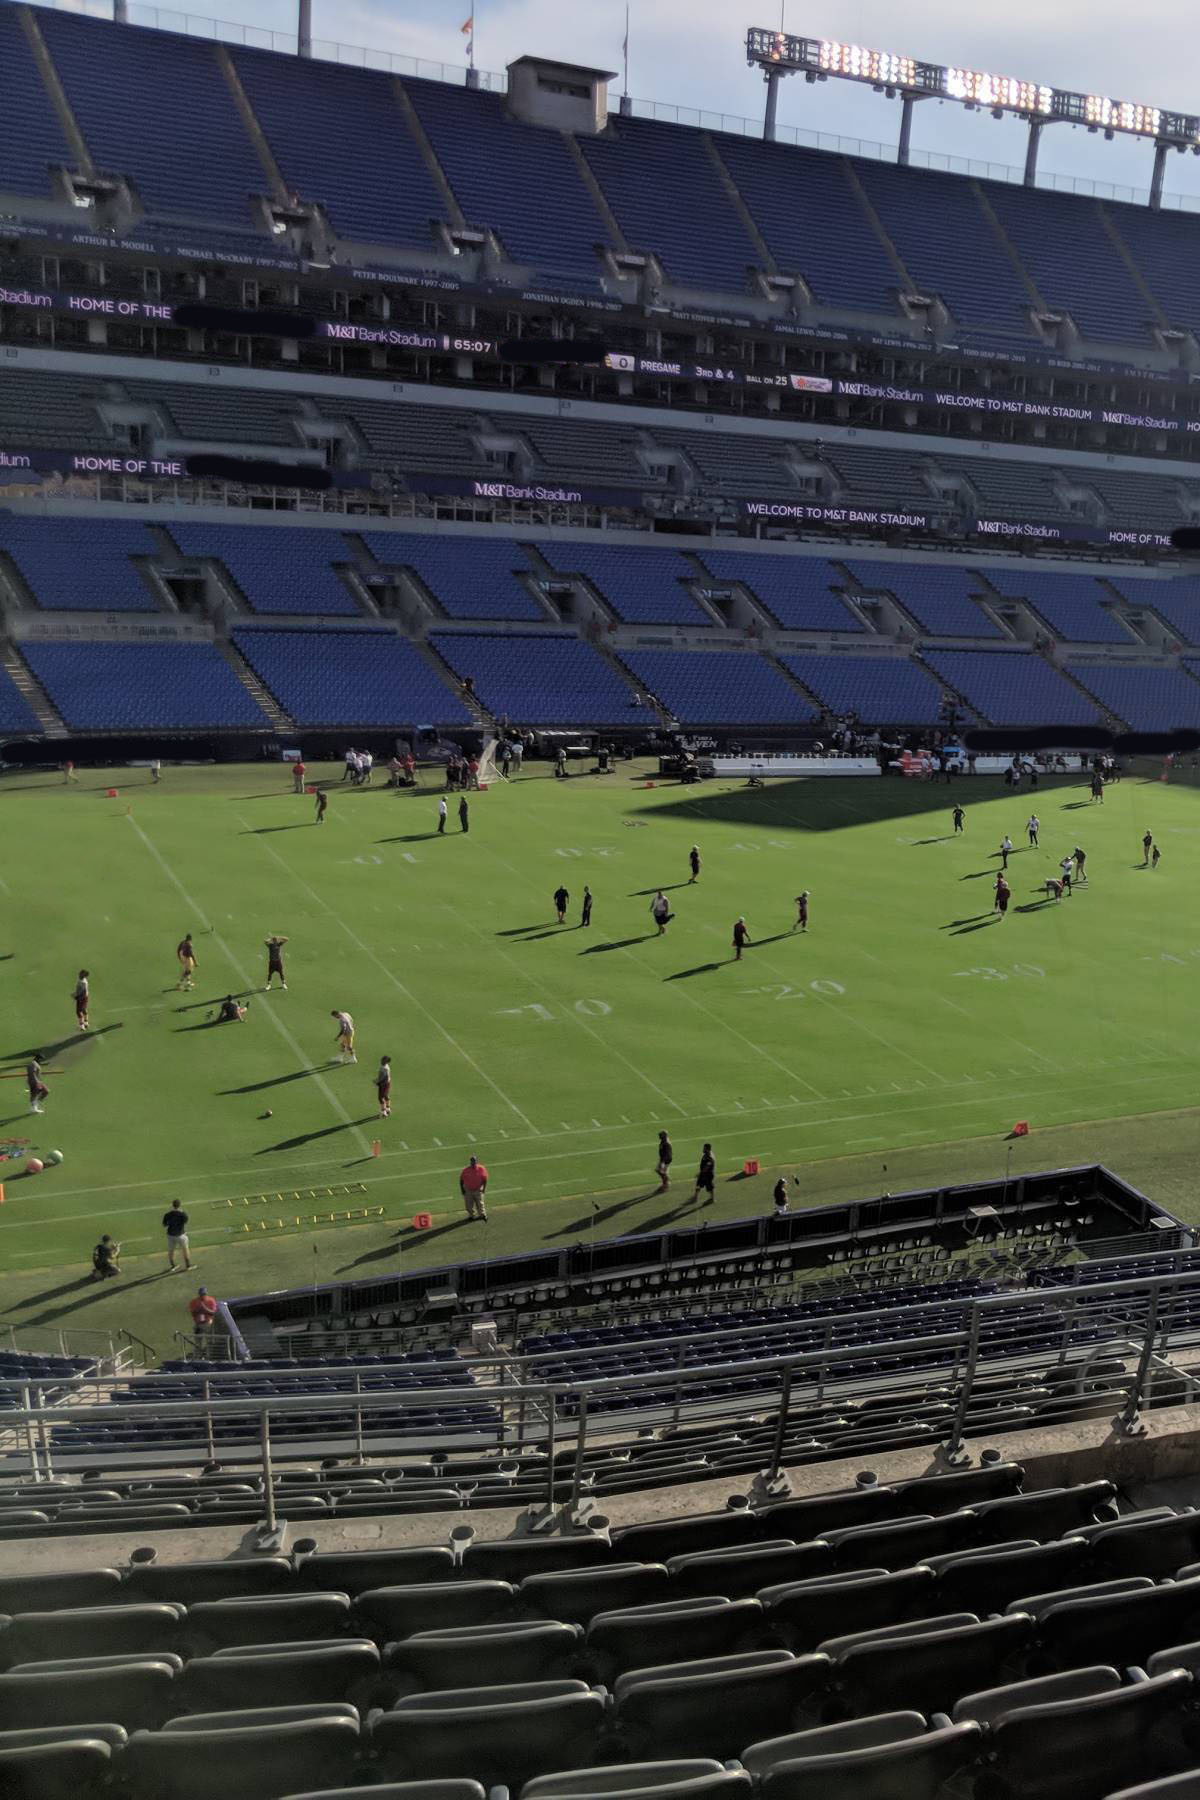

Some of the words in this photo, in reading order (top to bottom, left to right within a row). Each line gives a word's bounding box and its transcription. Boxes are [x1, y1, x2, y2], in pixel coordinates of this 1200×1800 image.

[72, 235, 107, 246] ARTHUR
[120, 240, 156, 252] MODELL
[176, 248, 214, 260] MICHAEL
[353, 270, 378, 281] PETER
[69, 297, 115, 313] HOME
[118, 302, 138, 315] OF
[143, 304, 171, 319] THE
[560, 296, 585, 307] OGDEN
[327, 323, 359, 340] M&T
[359, 327, 388, 343] Bank
[389, 331, 436, 348] Stadium
[454, 339, 491, 353] 65:07
[640, 360, 680, 374] PREGAME
[775, 376, 787, 386] 25
[838, 381, 864, 394] M&T
[863, 384, 886, 398] Bank
[886, 387, 924, 402] Stadium
[936, 394, 985, 409] WELCOME
[987, 399, 1001, 410] TO
[1002, 401, 1024, 413] M&T
[1025, 403, 1050, 416] BANK
[1052, 407, 1092, 420] STADIUM
[1102, 411, 1124, 424] M&T
[1123, 413, 1144, 426] Bank
[1144, 416, 1178, 430] Stadium
[73, 456, 122, 471] HOME
[125, 459, 147, 473] OF
[151, 461, 181, 475] THE
[474, 482, 506, 497] M&T
[506, 486, 535, 499] Bank
[535, 487, 582, 502] Stadium
[747, 503, 803, 517] WELCOME
[806, 507, 822, 519] TO
[824, 509, 847, 521] M&T
[849, 511, 878, 524] BANK
[879, 513, 925, 527] STADIUM
[977, 520, 1001, 533] M&T
[1001, 523, 1023, 535] Bank
[1023, 524, 1060, 538] Stadium
[1109, 532, 1137, 543] HOME
[1139, 534, 1152, 544] OF
[1154, 535, 1172, 546] THE
[761, 979, 846, 1001] 20
[523, 998, 612, 1020] 10
[419, 1215, 429, 1228] G
